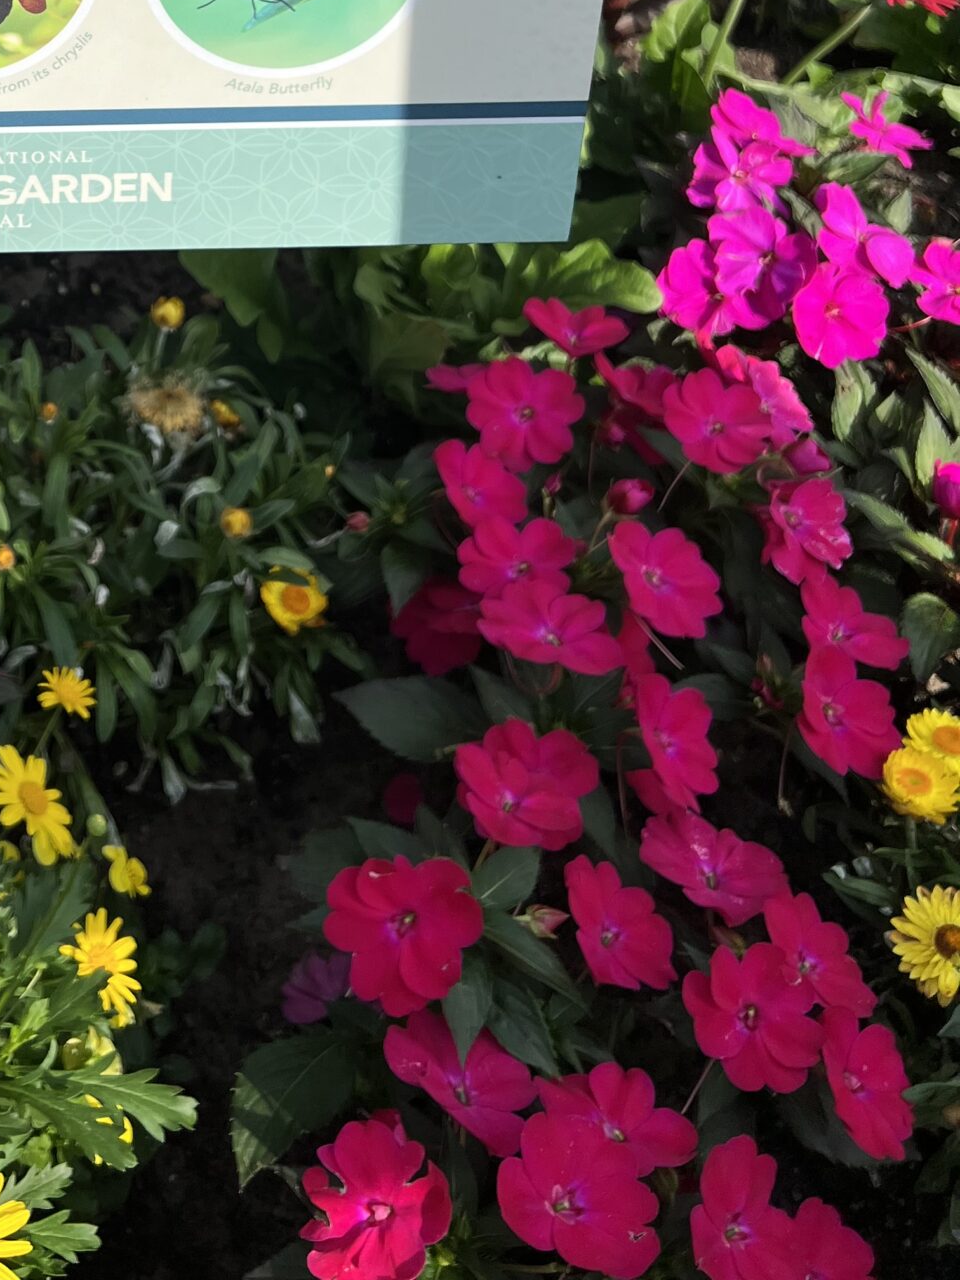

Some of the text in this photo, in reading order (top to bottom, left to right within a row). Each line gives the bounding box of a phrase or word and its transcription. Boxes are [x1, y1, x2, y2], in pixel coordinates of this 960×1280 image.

[33, 69, 50, 83] its
[52, 30, 94, 72] chryslis
[224, 76, 334, 95] Atala Butterfly
